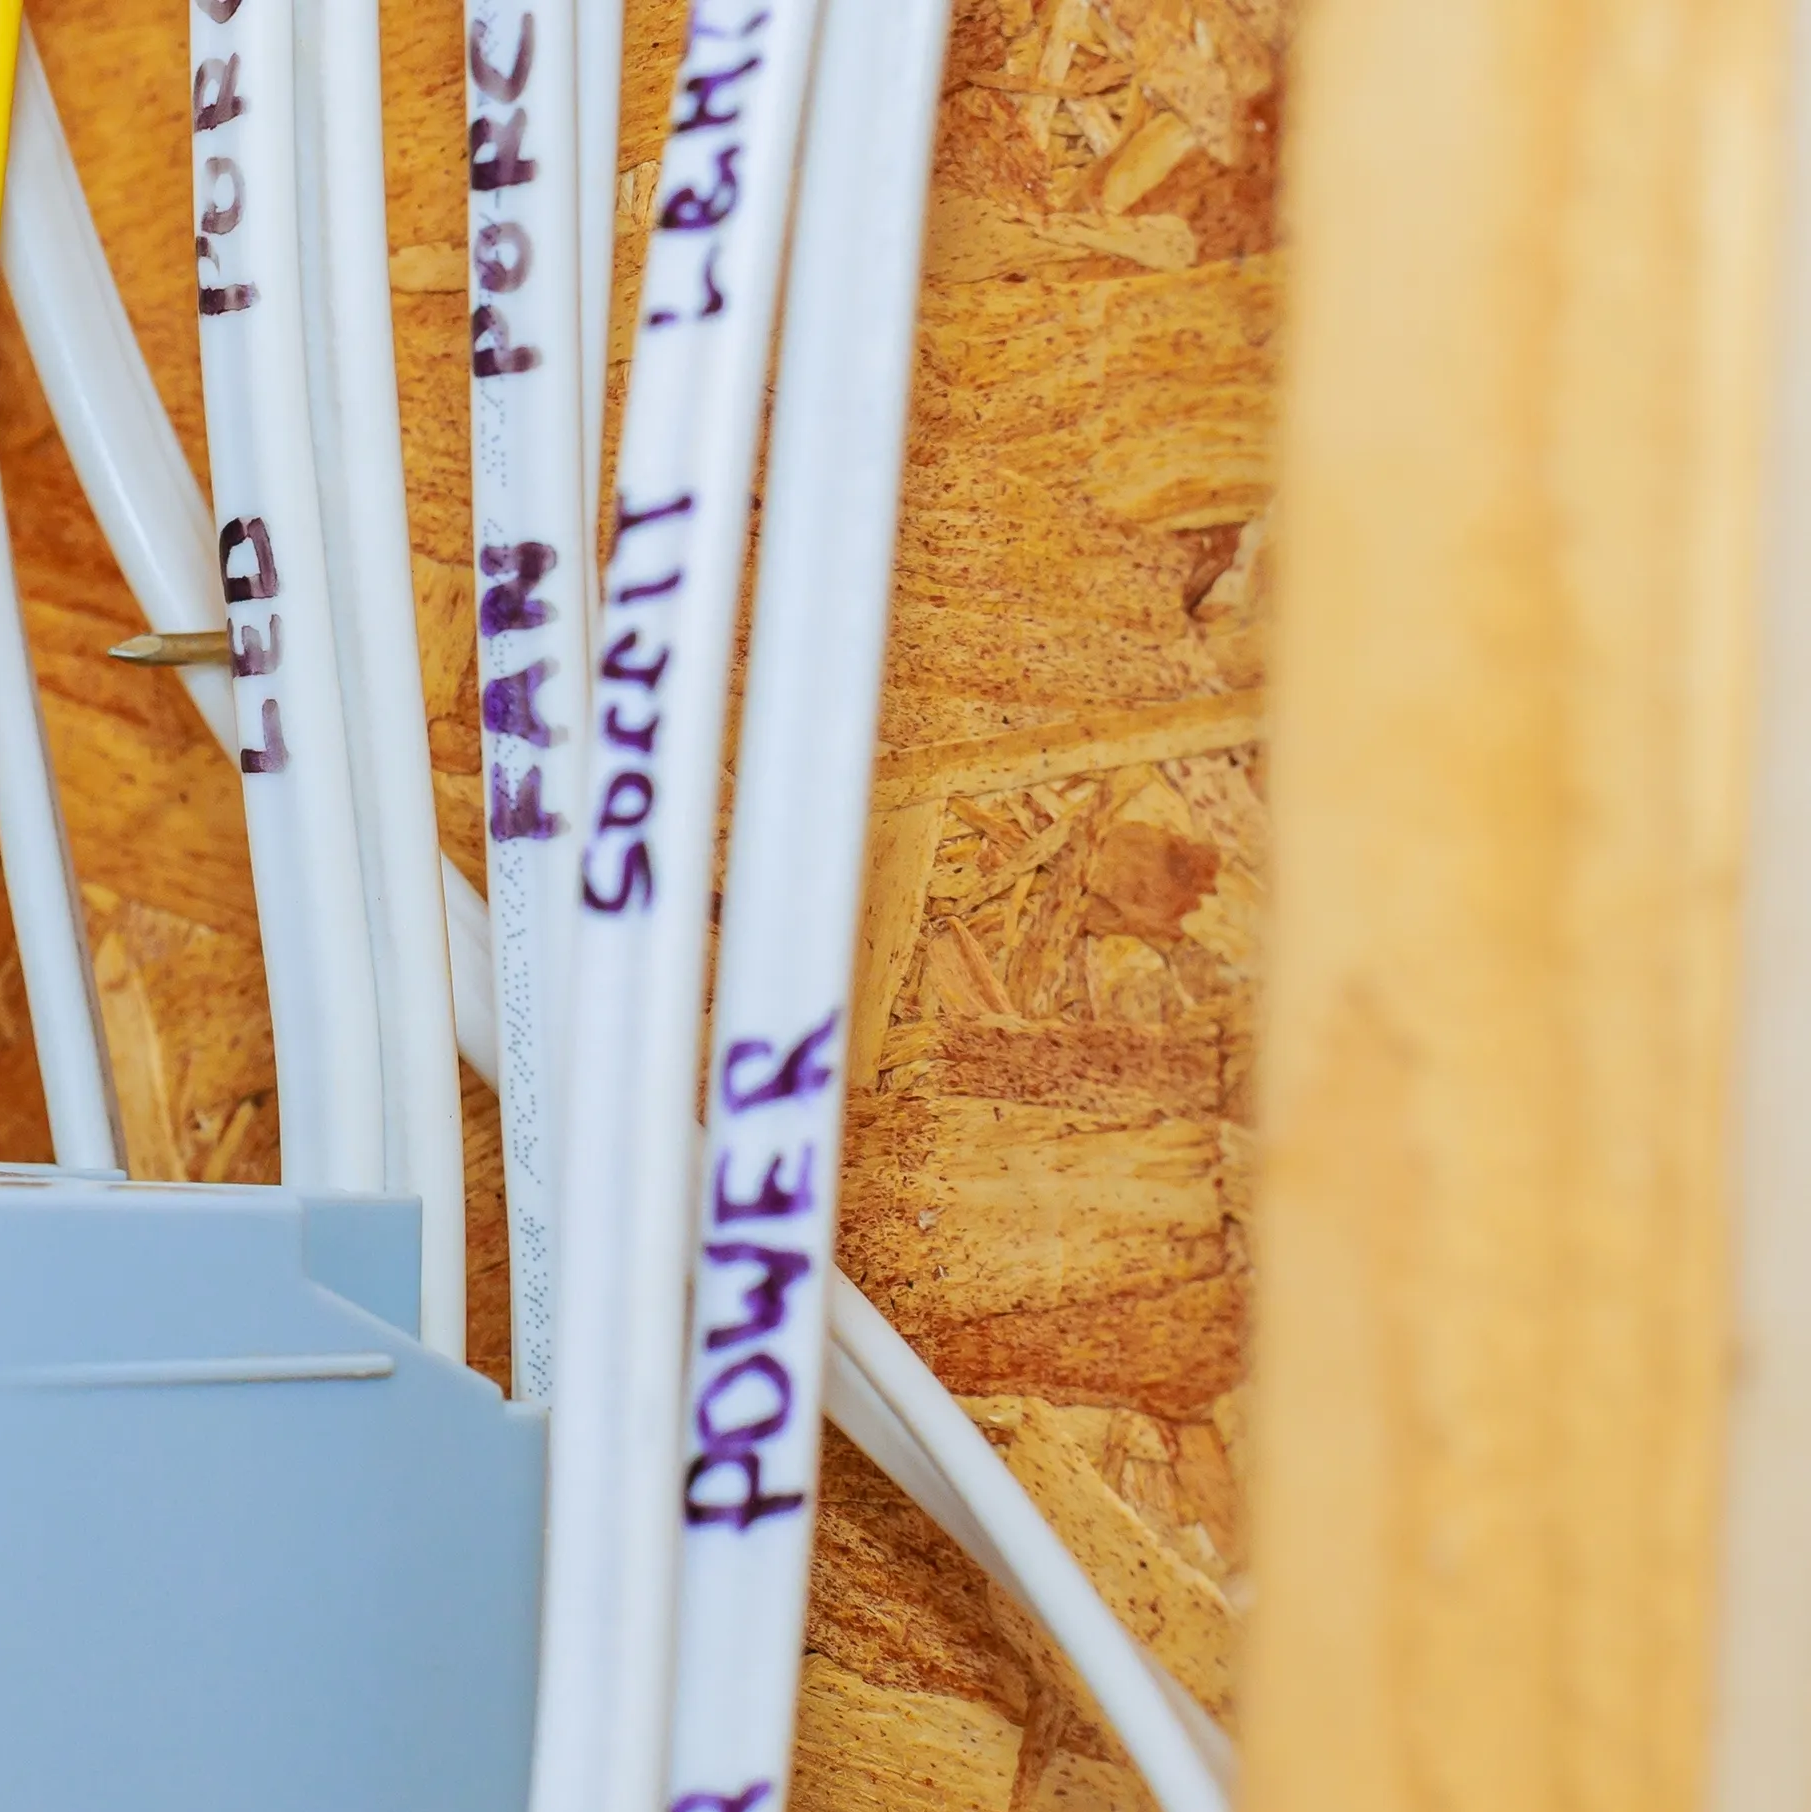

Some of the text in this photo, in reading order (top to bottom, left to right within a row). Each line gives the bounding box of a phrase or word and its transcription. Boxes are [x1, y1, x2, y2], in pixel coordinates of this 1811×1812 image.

[194, 0, 290, 774] LED POR
[480, 541, 570, 841] FAN
[683, 1007, 843, 1533] POWER
